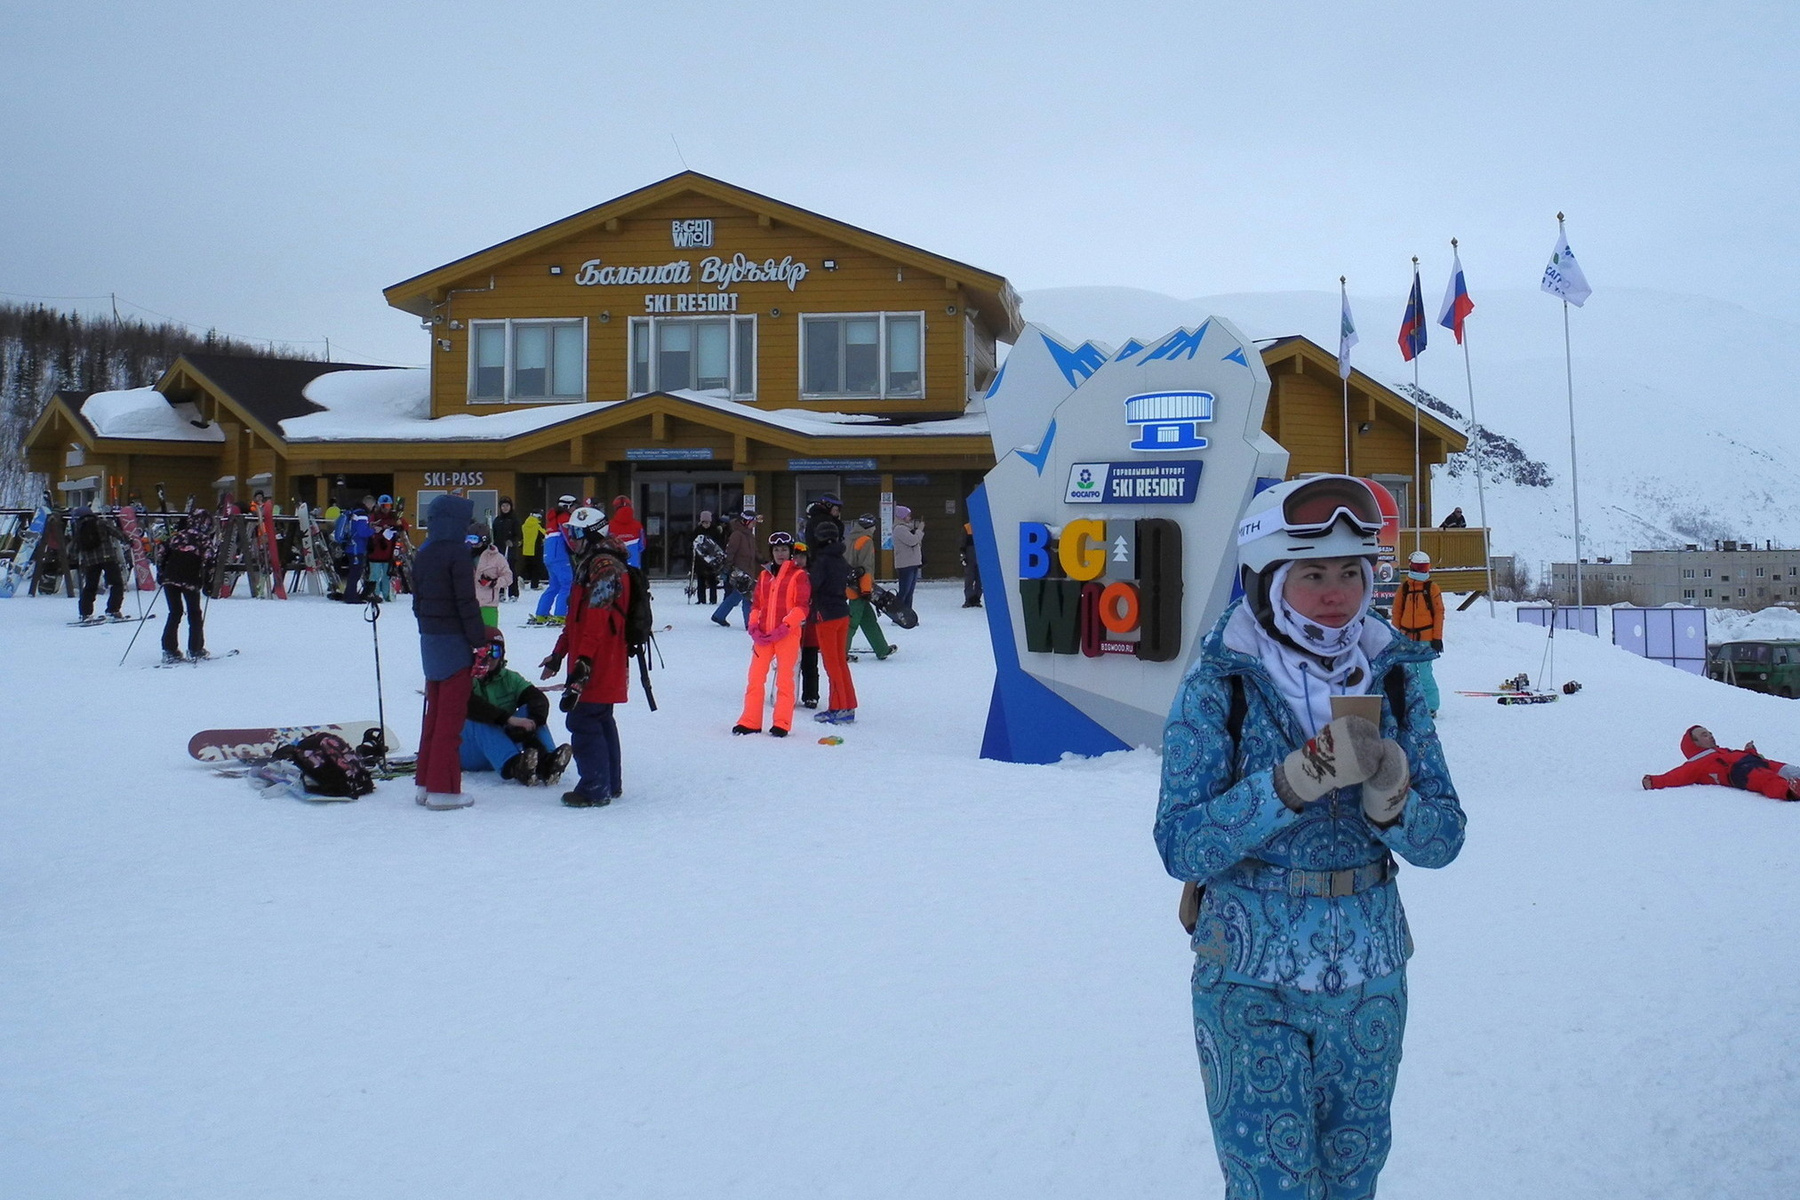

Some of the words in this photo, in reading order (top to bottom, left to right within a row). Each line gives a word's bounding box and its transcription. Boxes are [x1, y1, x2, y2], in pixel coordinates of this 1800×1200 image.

[575, 259, 692, 286] Большой
[700, 252, 809, 292] Вудъявр
[645, 294, 671, 312] SKI
[676, 292, 738, 312] RESORT
[424, 472, 484, 486] SKI-PASS
[1161, 467, 1186, 475] КУРОРТ
[1071, 490, 1100, 498] ФОСАГРО
[1112, 479, 1133, 497] SKI
[1136, 478, 1185, 497] RESORT
[121, 518, 146, 562] ROXY
